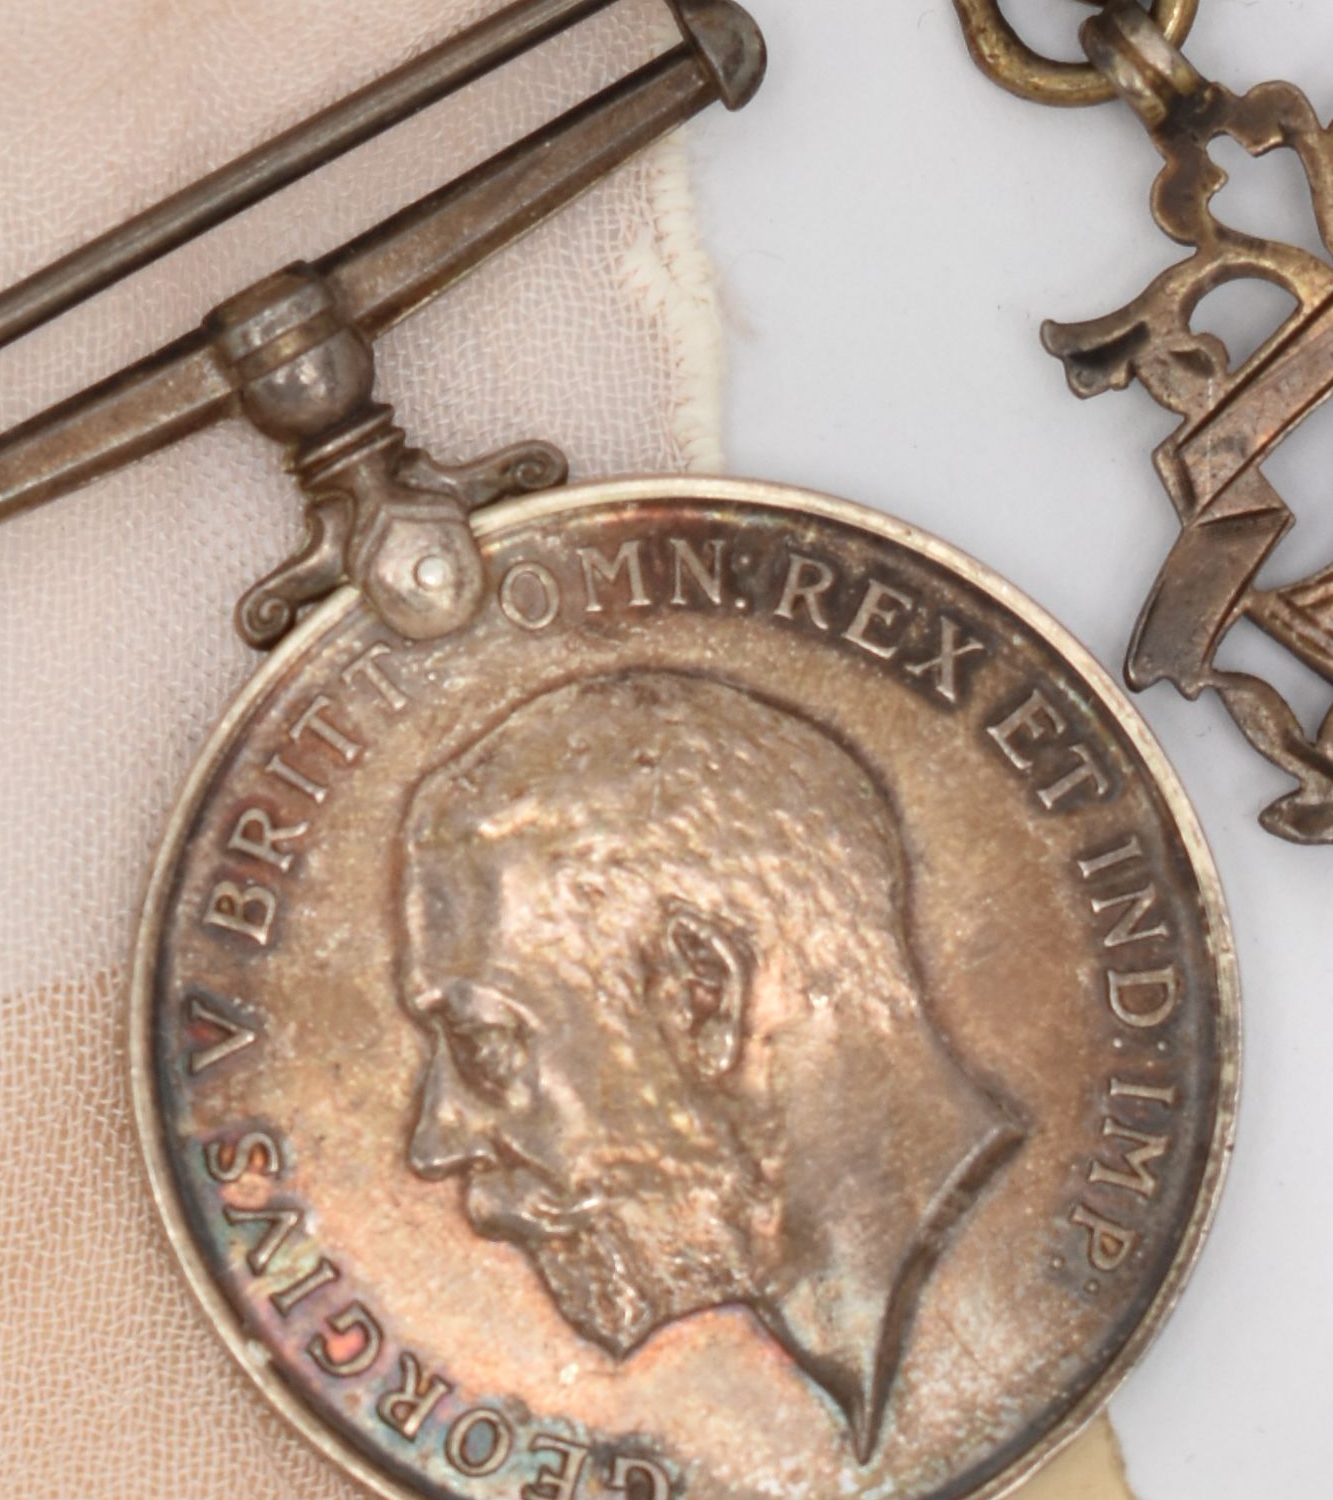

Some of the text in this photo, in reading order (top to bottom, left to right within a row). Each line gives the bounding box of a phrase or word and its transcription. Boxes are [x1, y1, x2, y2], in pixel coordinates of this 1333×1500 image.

[771, 552, 994, 706] REX
[206, 639, 417, 949] BRITT
[985, 688, 1111, 812] ET
[187, 998, 259, 1076] V
